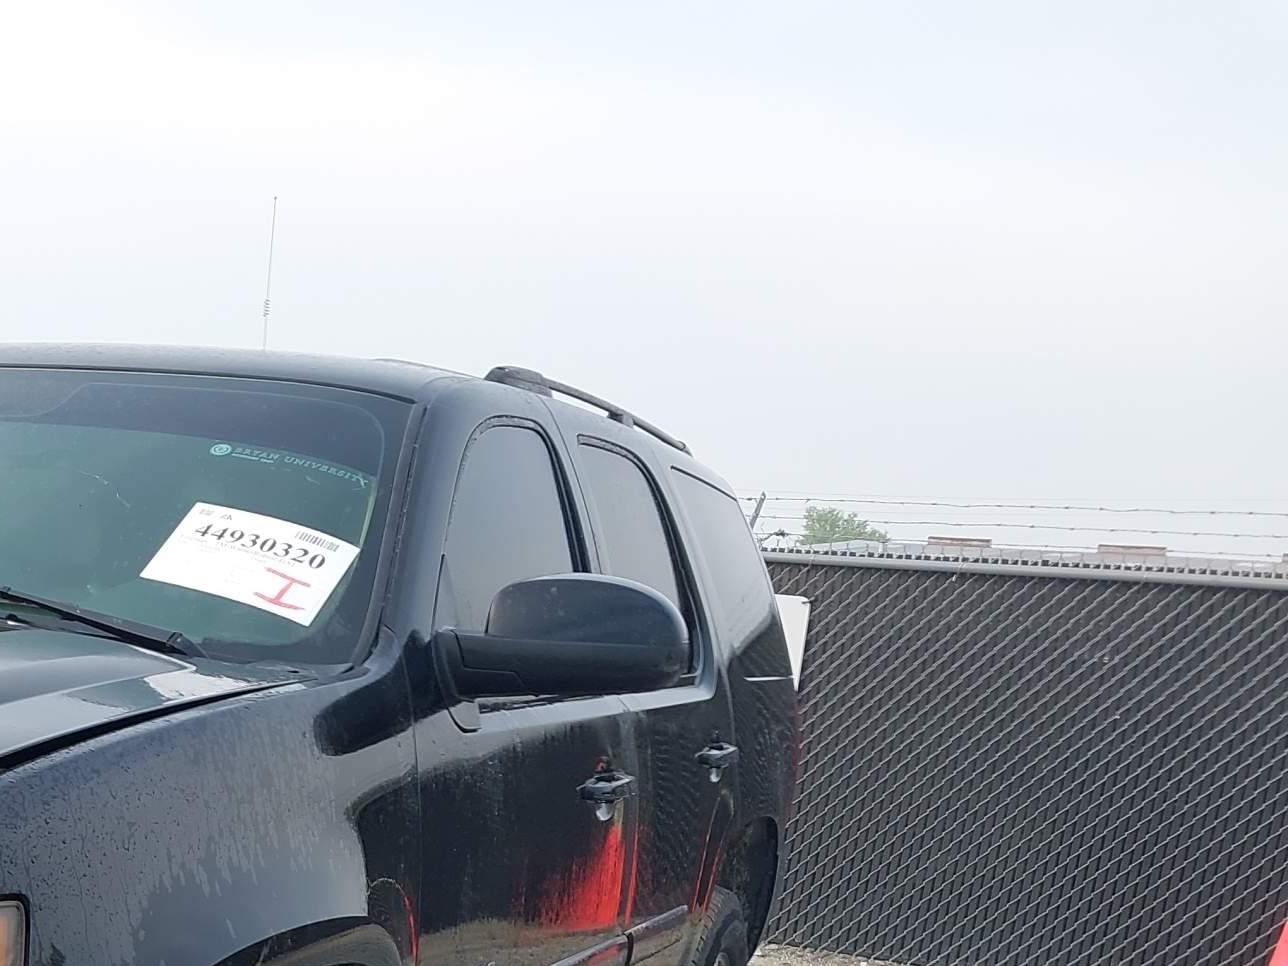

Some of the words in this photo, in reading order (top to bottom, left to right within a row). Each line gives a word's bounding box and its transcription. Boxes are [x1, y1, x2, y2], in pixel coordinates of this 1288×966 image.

[233, 446, 280, 461] BRYAN
[283, 455, 369, 488] UNIVERSITY
[195, 523, 326, 569] 44930320
